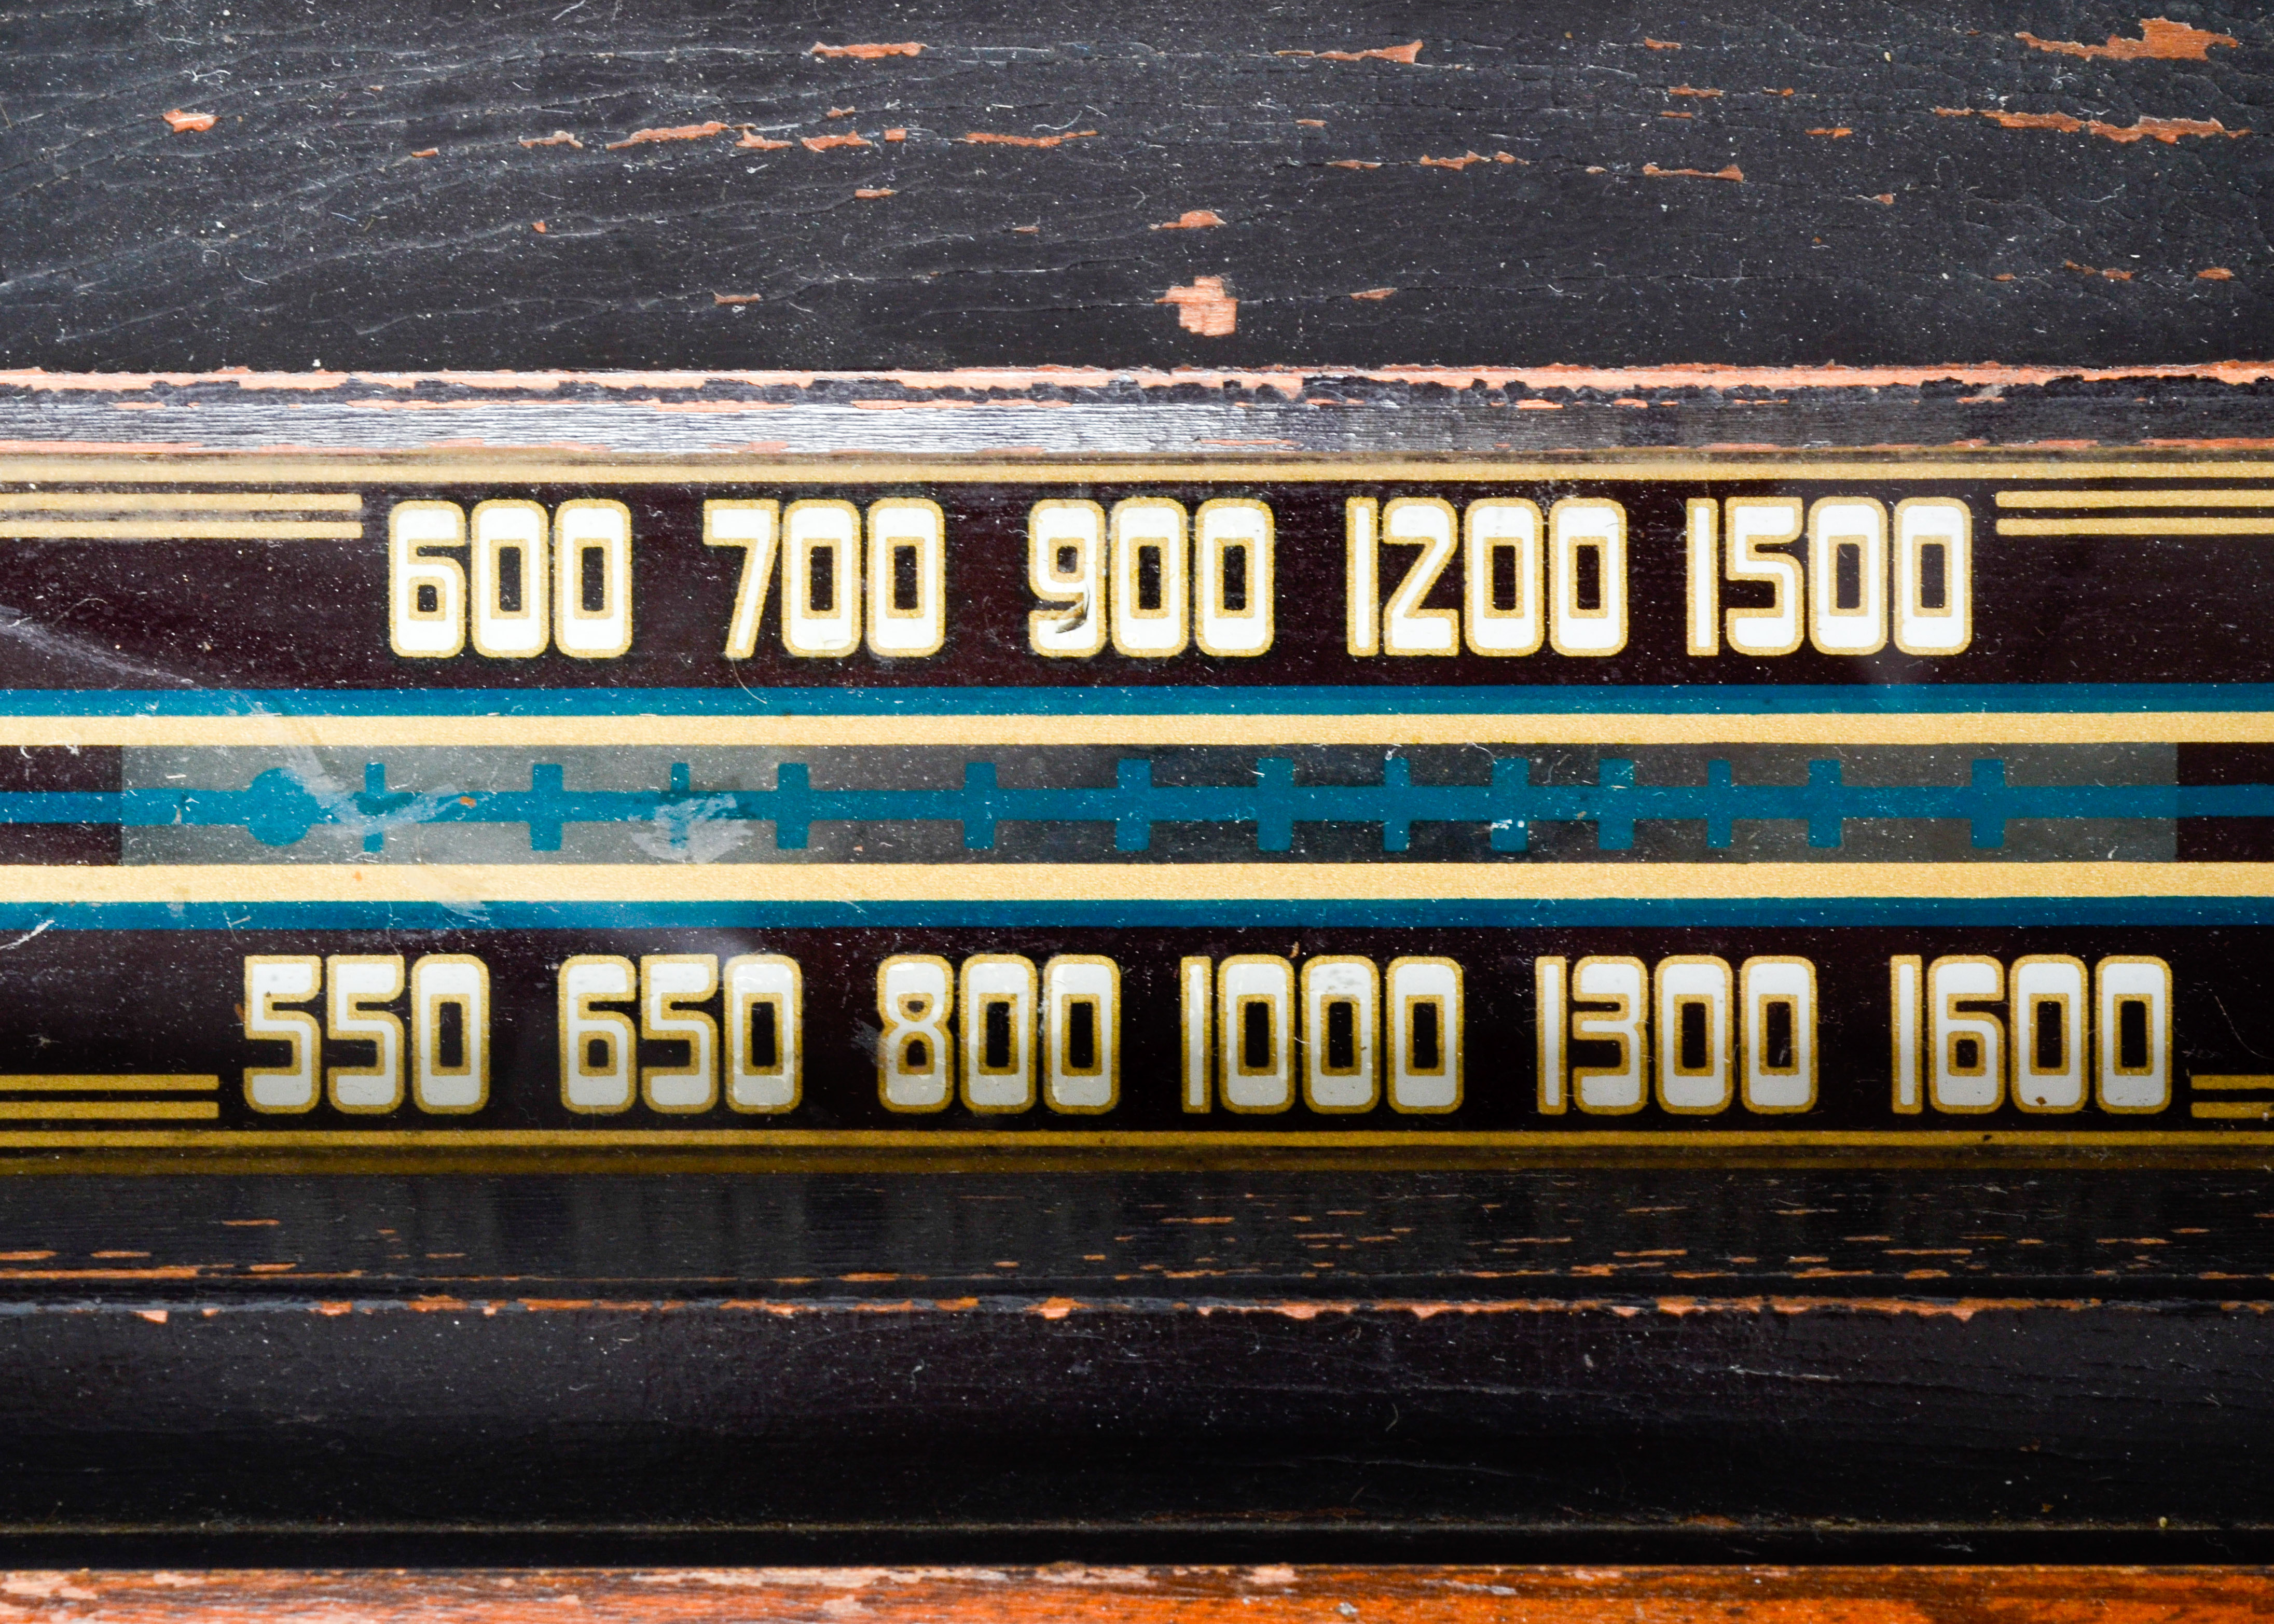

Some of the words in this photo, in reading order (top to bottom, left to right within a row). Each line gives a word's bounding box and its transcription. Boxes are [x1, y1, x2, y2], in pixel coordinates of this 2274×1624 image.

[388, 498, 633, 659] 600
[703, 497, 946, 660] 700
[1027, 496, 1276, 658] 900
[1346, 496, 1628, 656] 1200
[1683, 496, 1974, 656] 1500
[242, 953, 490, 1113] 550
[558, 953, 802, 1113] 650
[877, 953, 1121, 1113] 800
[1180, 954, 1464, 1113] 1000
[1535, 955, 1818, 1114] 1300
[1890, 954, 2172, 1114] 1600
